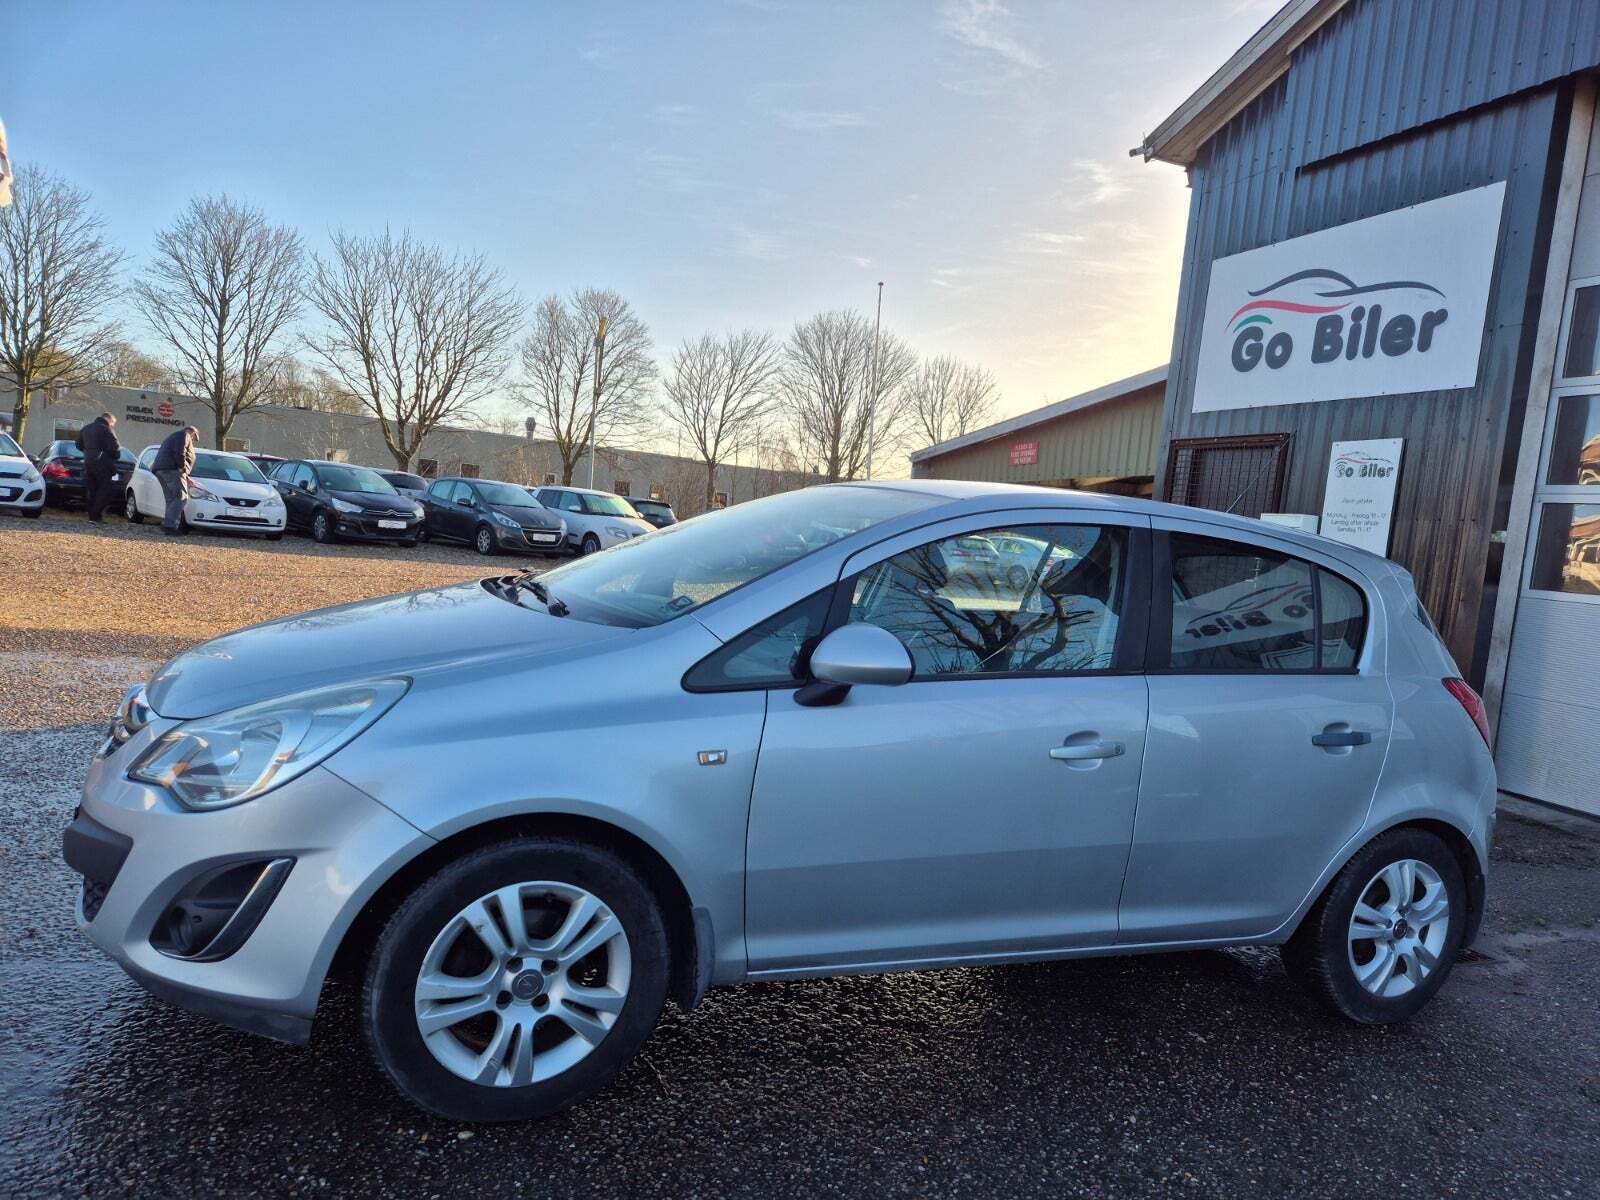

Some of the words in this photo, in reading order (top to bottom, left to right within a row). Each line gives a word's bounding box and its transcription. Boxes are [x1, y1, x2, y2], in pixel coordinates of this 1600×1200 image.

[1231, 326, 1294, 373] Go
[1311, 304, 1448, 364] Biler
[1359, 463, 1393, 478] Biler
